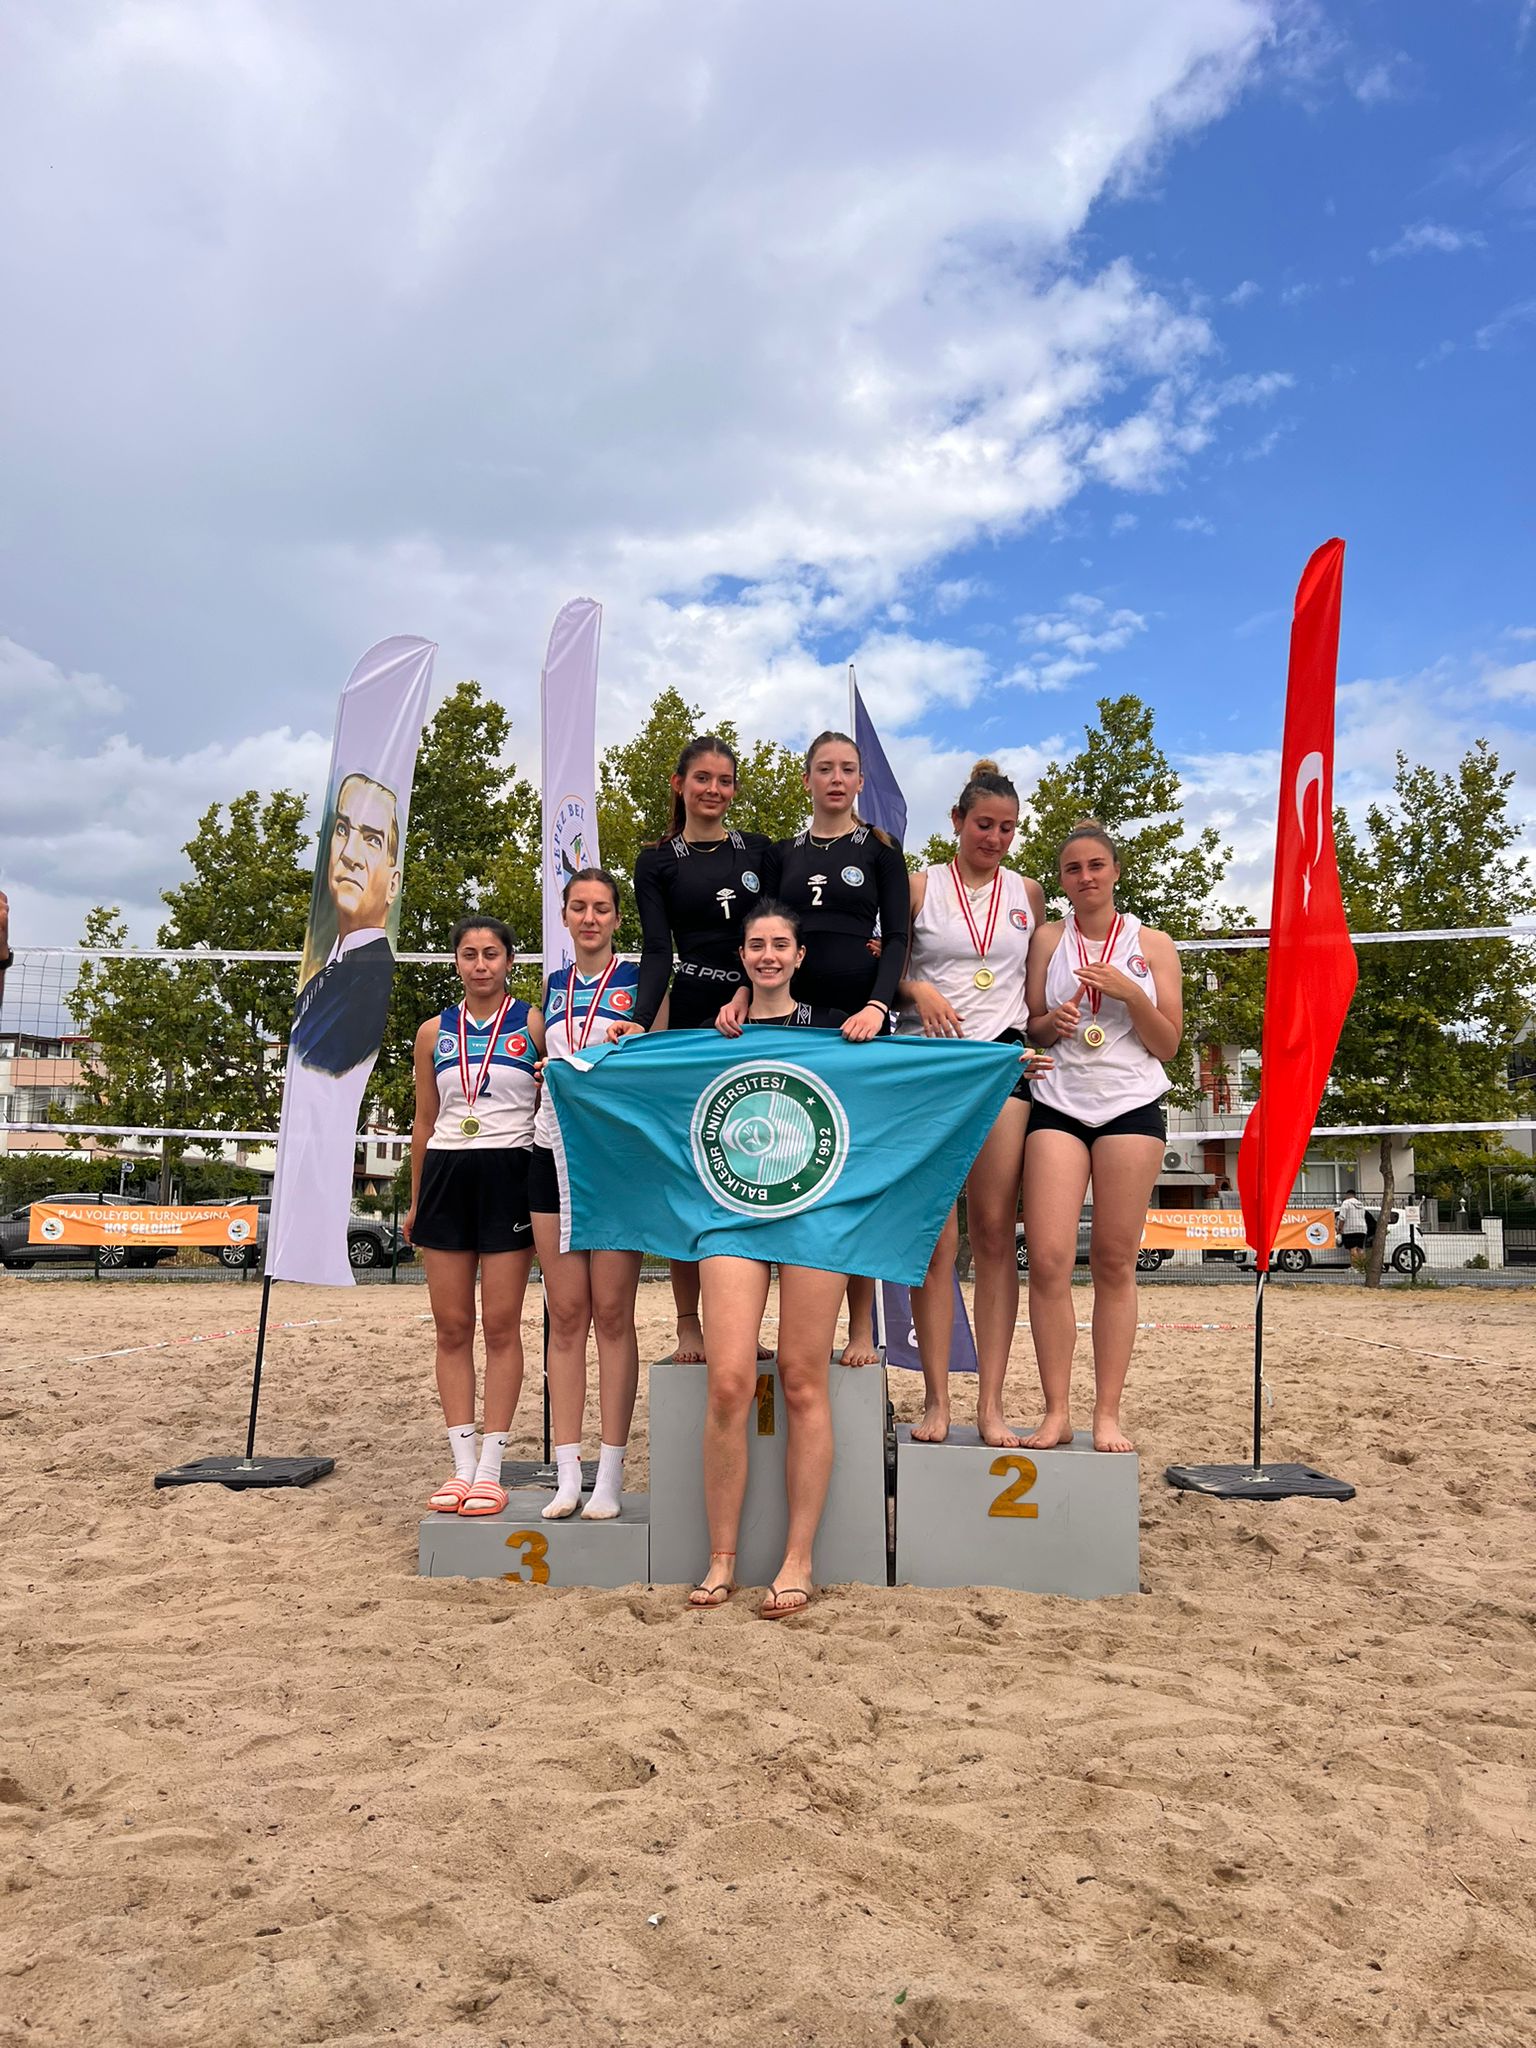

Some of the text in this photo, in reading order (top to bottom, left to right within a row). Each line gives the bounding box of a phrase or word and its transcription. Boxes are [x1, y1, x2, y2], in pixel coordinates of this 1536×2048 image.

[554, 809, 567, 876] KEPEZ
[811, 886, 823, 906] 2
[720, 900, 730, 919] 1
[680, 962, 742, 982] KE PRO
[476, 1071, 492, 1098] 2
[703, 1076, 788, 1201] BALIKESİR ÜNİVERSİTESİ
[815, 1126, 832, 1166] 1992
[58, 1209, 231, 1222] PLAJ VOLEYBOL TURNUVASINA
[1146, 1214, 1163, 1224] LAJ
[1166, 1214, 1224, 1224] VOLEYBOL
[104, 1221, 183, 1237] HOŞ GELDİNİZ
[1186, 1225, 1247, 1241] HOŞ GELDİ
[988, 1454, 1039, 1519] 2
[501, 1529, 551, 1585] 3
